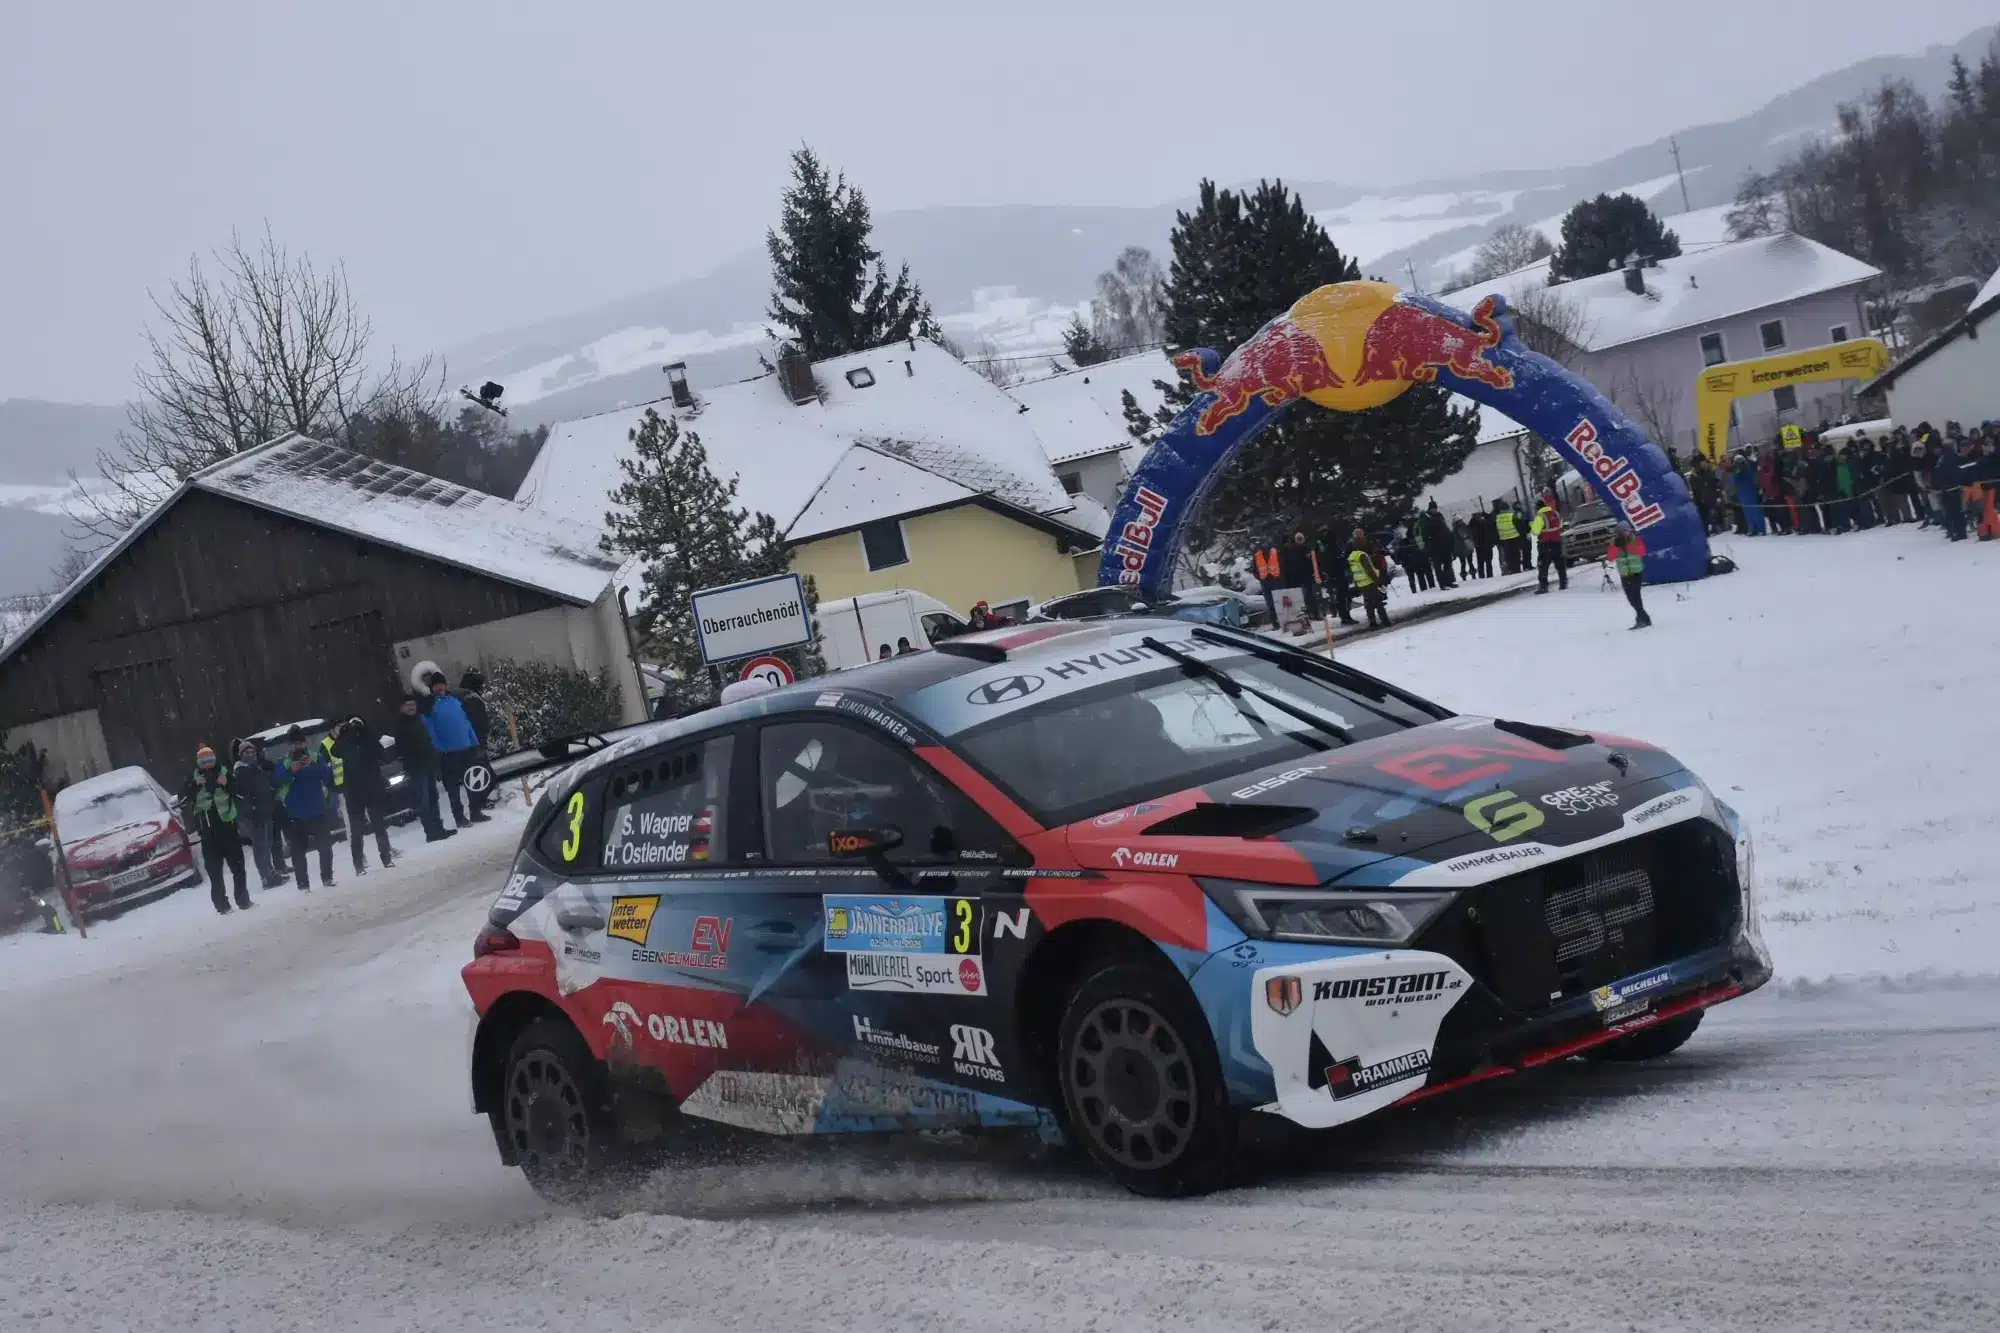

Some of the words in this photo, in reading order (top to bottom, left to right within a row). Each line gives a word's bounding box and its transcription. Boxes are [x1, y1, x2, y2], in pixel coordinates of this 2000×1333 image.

[1752, 360, 1830, 384] interwetten
[1564, 418, 1628, 481] Red
[1607, 468, 1665, 531] Bull
[1122, 486, 1168, 549] Bull
[1116, 543, 1147, 585] ed
[702, 601, 800, 636] Oberrauchenödt
[1557, 793, 1619, 816] SCRAP
[562, 791, 584, 861] 3
[621, 813, 635, 836] S.
[640, 812, 693, 839] Wagner
[604, 843, 618, 865] H.
[622, 841, 689, 865] Ostlender
[1133, 851, 1179, 868] ORLEN
[1447, 846, 1545, 873] HIMMELBAUER
[1011, 869, 1036, 877] MOTORS
[612, 916, 647, 930] wetten
[613, 903, 639, 916] inter
[850, 906, 944, 937] JÄNNERRALLYE
[993, 908, 1031, 940] N
[691, 916, 734, 953] EN
[954, 900, 972, 953] 3
[850, 953, 912, 978] MÜHLVIERTEL
[916, 966, 954, 988] Sport
[1621, 972, 1669, 995] MICHELIN
[1364, 993, 1442, 1007] workwear
[648, 1013, 729, 1050] ORLEN
[852, 1014, 940, 1055] Himmelbauer
[953, 1061, 1005, 1083] MOTORS
[1351, 1051, 1429, 1087] PRAMMER
